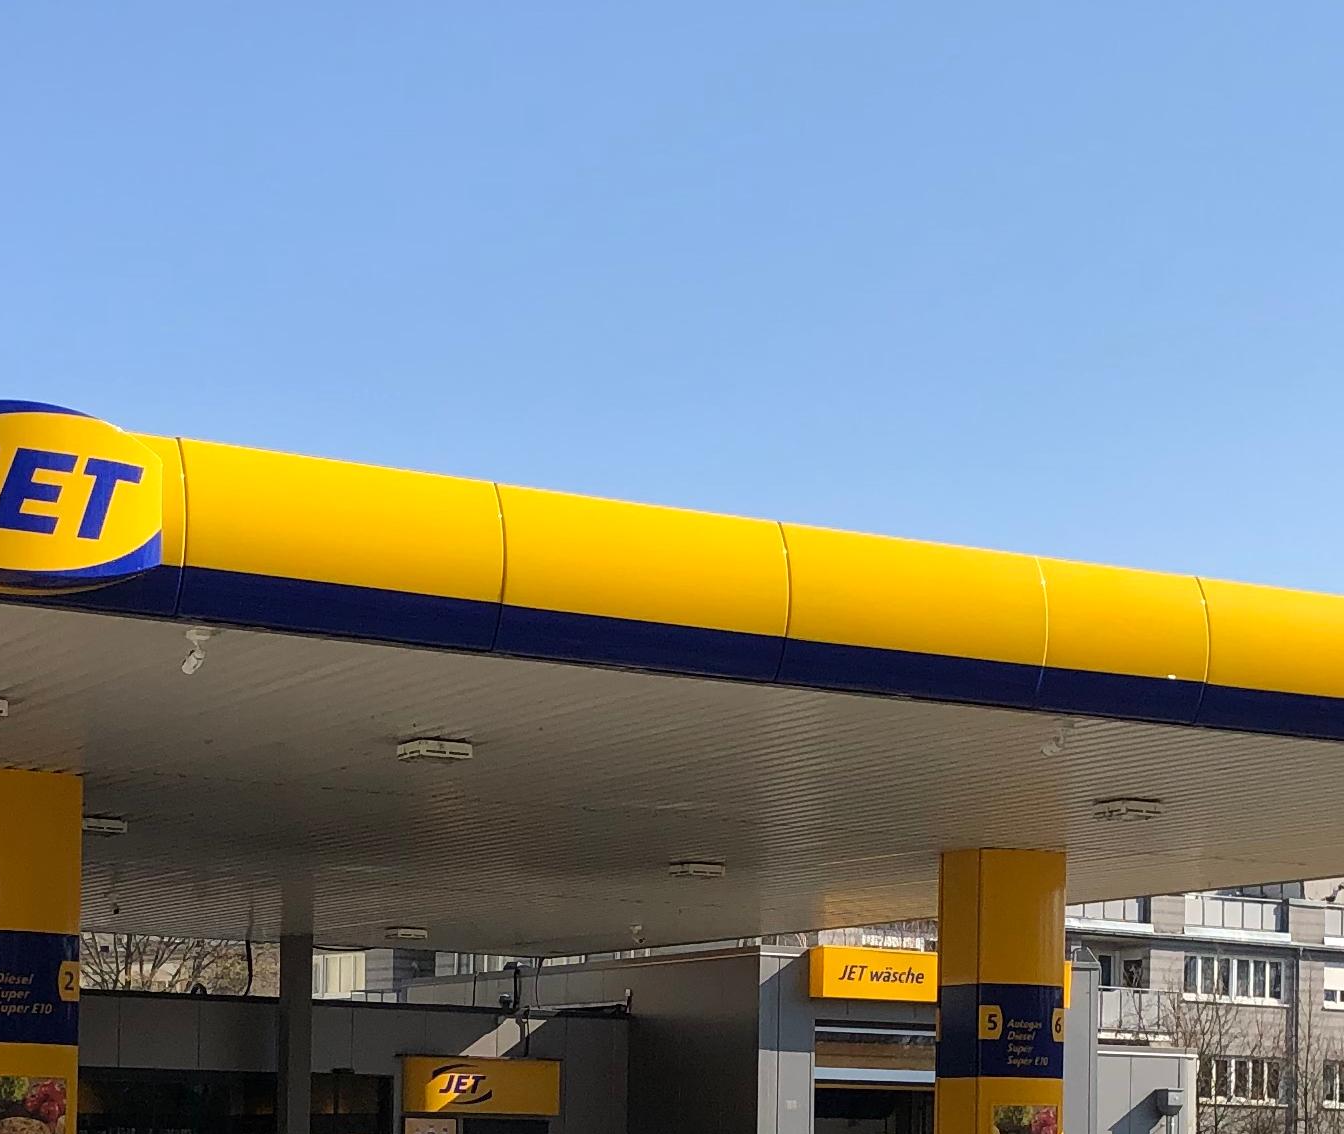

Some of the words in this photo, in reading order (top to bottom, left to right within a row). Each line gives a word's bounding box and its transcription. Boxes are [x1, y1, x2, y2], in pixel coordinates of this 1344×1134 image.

[64, 971, 74, 991] 2
[838, 965, 868, 981] JET
[870, 966, 925, 984] wäsche
[31, 1003, 53, 1014] E10
[987, 1014, 998, 1030] 5
[1055, 1017, 1062, 1033] 6
[439, 1075, 486, 1094] JET
